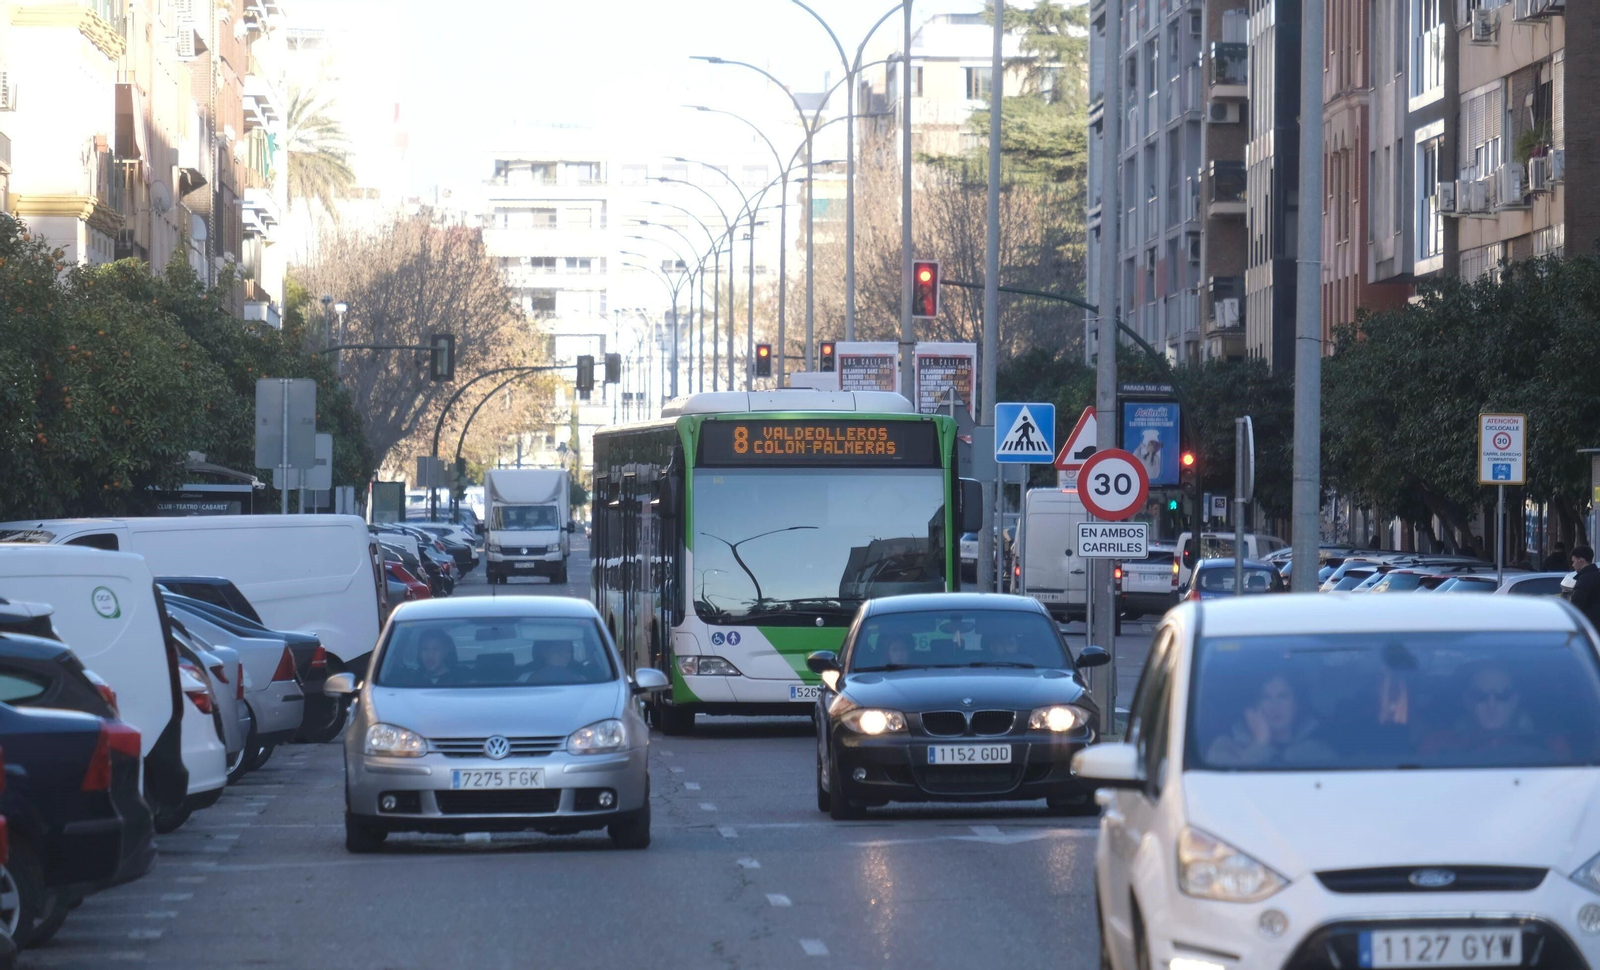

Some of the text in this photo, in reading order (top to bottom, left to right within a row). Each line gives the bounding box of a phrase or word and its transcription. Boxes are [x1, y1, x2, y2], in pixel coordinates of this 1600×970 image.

[734, 426, 748, 454] 8
[763, 427, 888, 440] VALDEOLLEROS
[1094, 473, 1131, 495] 30
[1082, 528, 1144, 538] EN AMBOS
[1083, 542, 1142, 552] CARRILES
[797, 687, 821, 698] 526
[941, 747, 1008, 761] 1152 GDD
[463, 772, 538, 787] 7275 FGK
[1384, 934, 1514, 962] 1127 GYW
